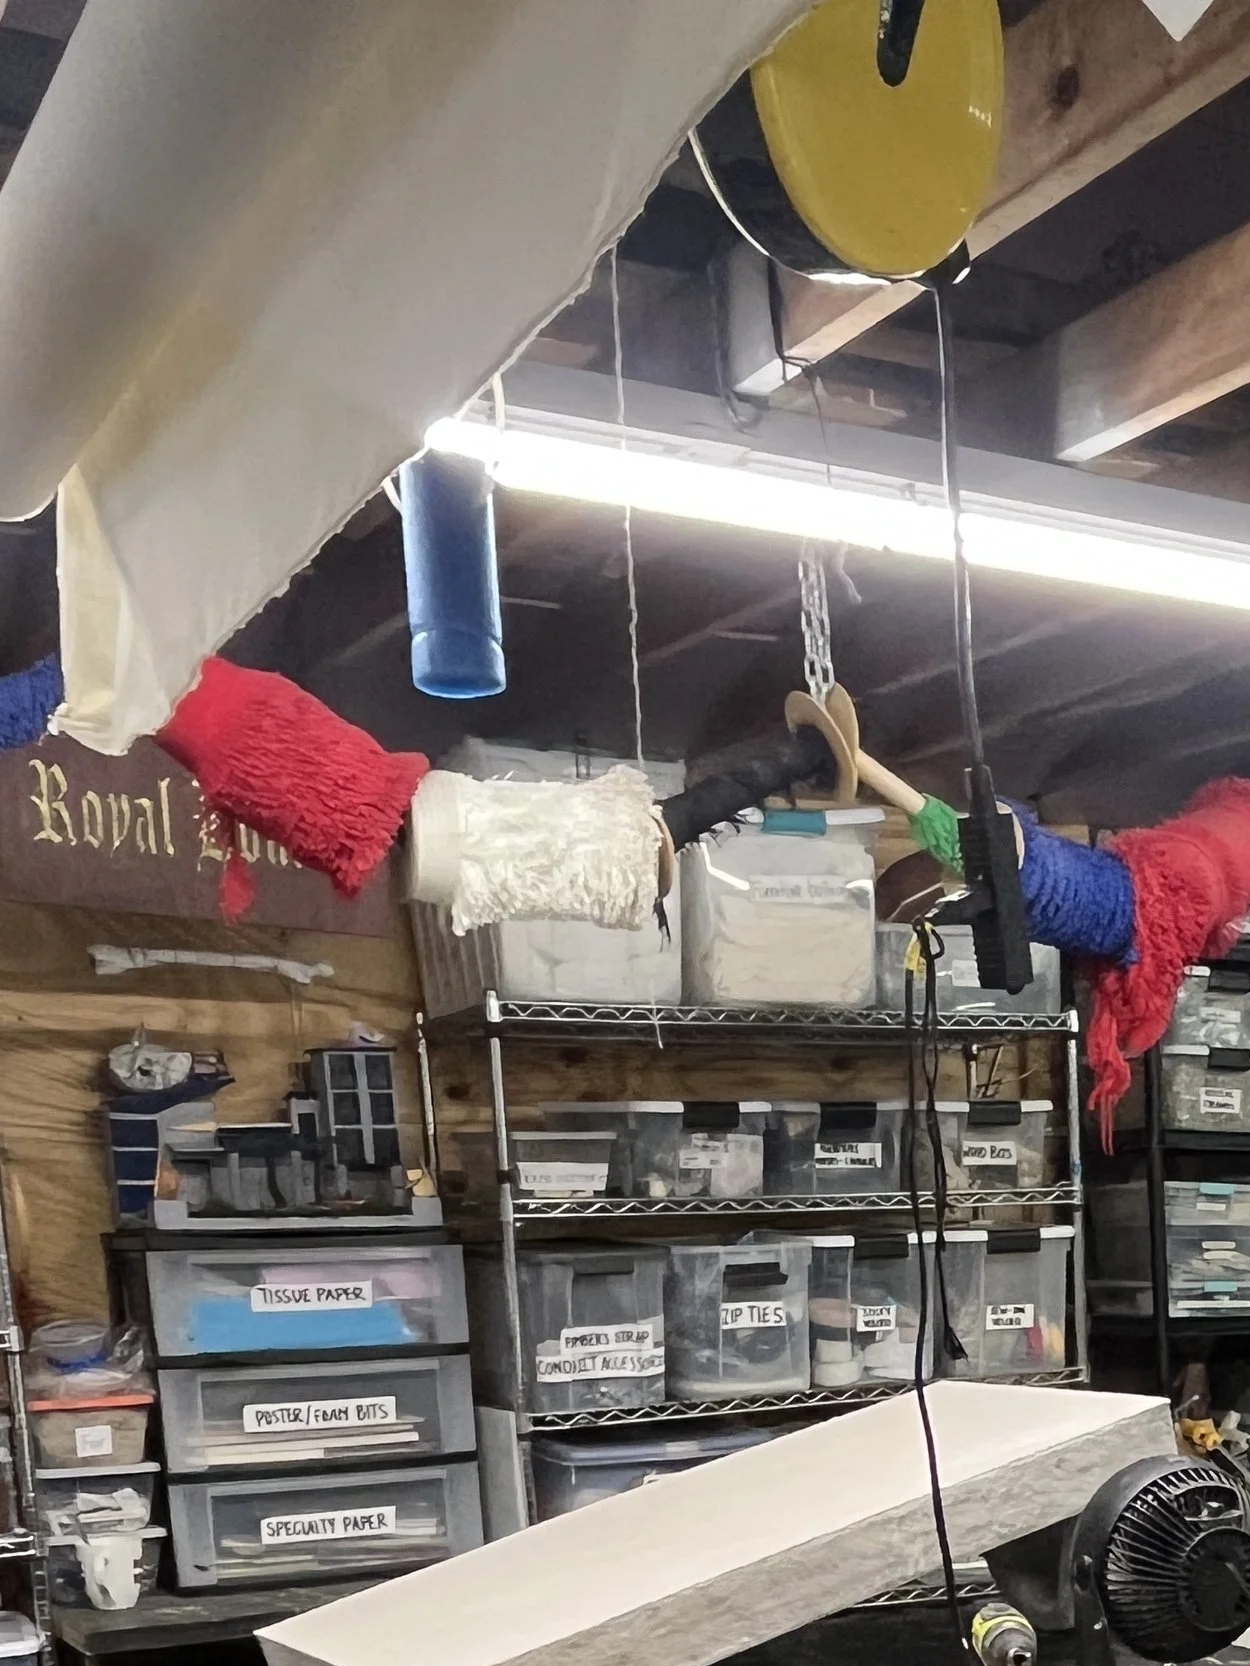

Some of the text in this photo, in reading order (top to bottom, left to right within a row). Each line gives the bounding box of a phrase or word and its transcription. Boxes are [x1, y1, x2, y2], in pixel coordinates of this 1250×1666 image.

[29, 759, 175, 858] Royal
[256, 1287, 367, 1305] TISSUE PAPER
[721, 1305, 783, 1325] ZIP TIES
[356, 1404, 389, 1421] BITS
[343, 1513, 388, 1532] PAPER
